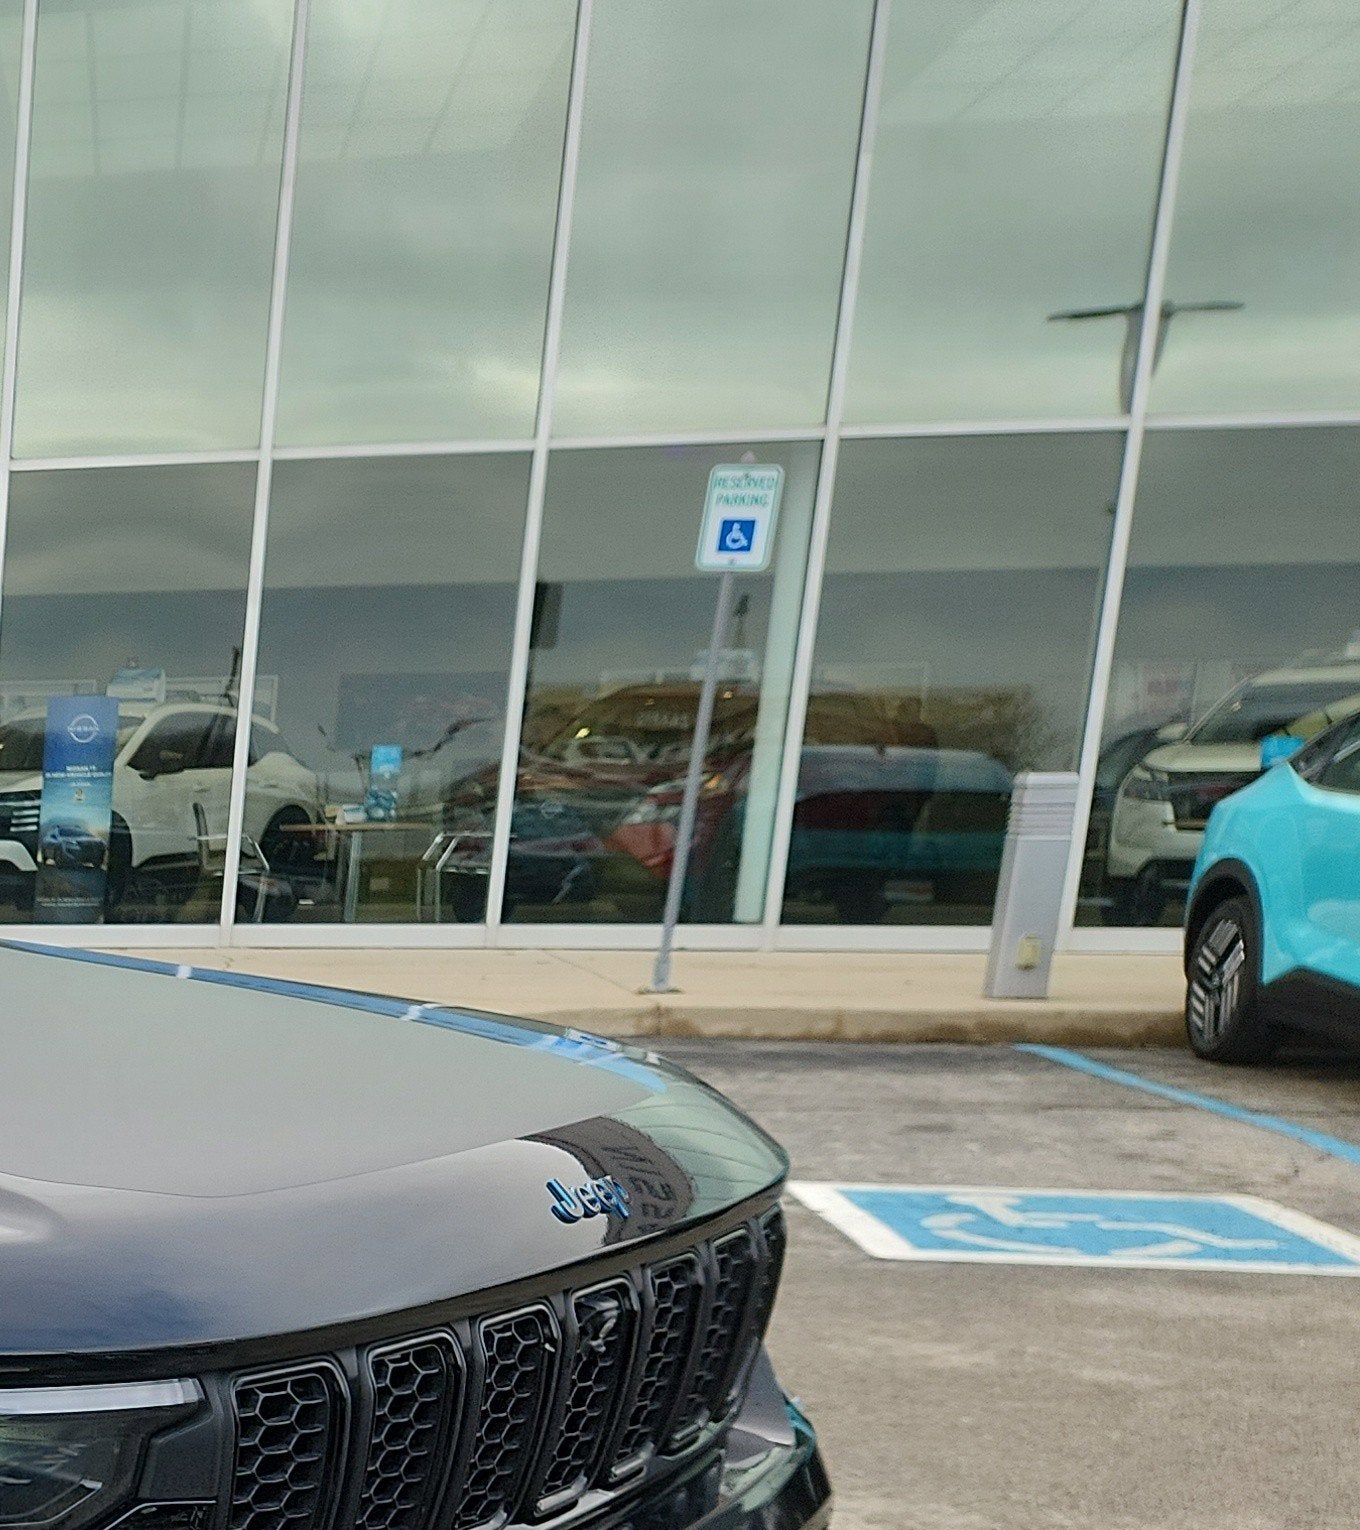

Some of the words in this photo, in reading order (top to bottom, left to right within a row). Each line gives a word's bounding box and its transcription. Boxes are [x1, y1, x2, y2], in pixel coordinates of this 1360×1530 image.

[713, 477, 775, 490] RESERVED
[716, 493, 769, 507] PARKING
[545, 1174, 631, 1225] Jeep
